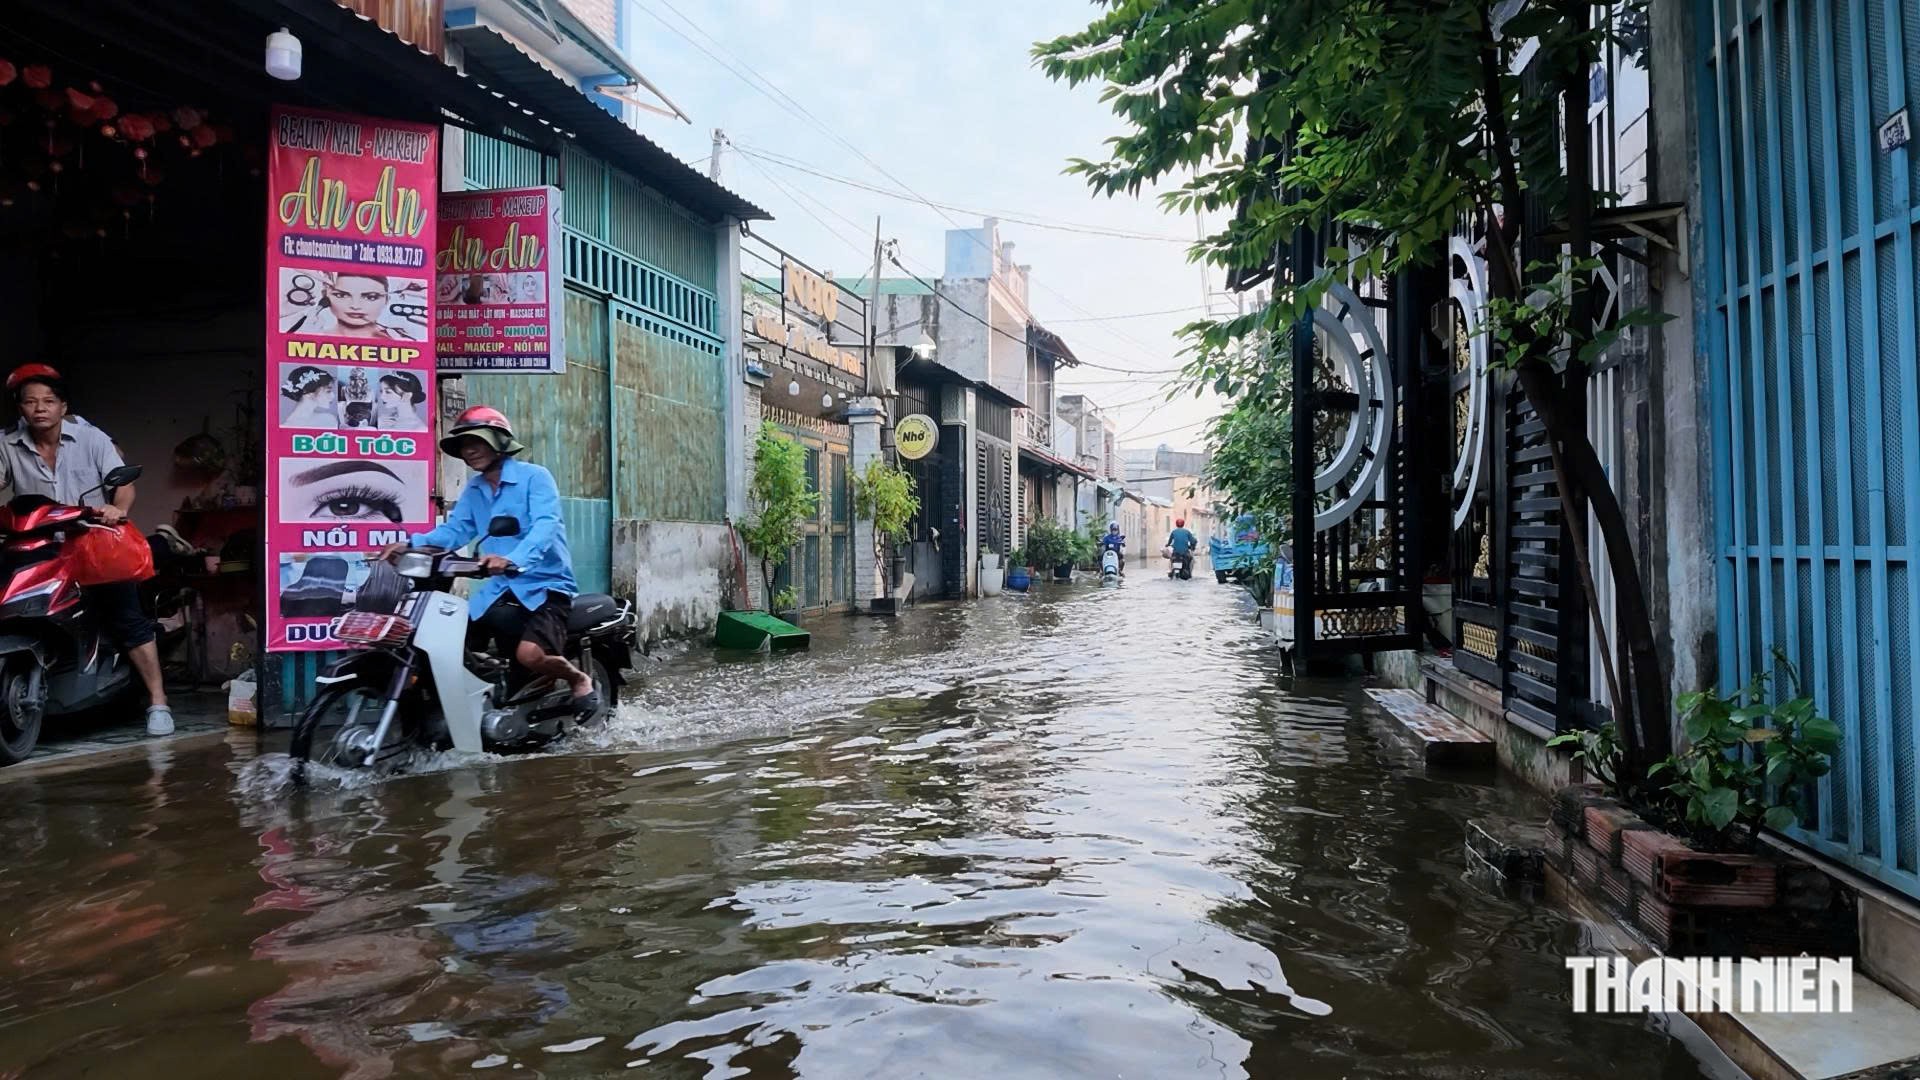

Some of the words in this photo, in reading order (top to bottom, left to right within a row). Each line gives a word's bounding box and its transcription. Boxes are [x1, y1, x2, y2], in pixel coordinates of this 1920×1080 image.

[280, 115, 329, 152] BEAUTY
[331, 120, 362, 155] NAIL
[373, 128, 428, 164] MAKEUP
[280, 157, 354, 229] An
[355, 166, 427, 237] An
[472, 199, 494, 219] NAIL
[502, 195, 545, 217] MAKEUP
[437, 225, 489, 272] An
[490, 222, 545, 272] An
[504, 323, 547, 339] NHUỘM
[288, 341, 420, 364] MAKEUP
[464, 342, 505, 353] MAKEUP
[534, 341, 547, 353] MI
[293, 432, 346, 454] BỚI
[356, 435, 416, 456] TÓC
[303, 525, 357, 547] NỐI
